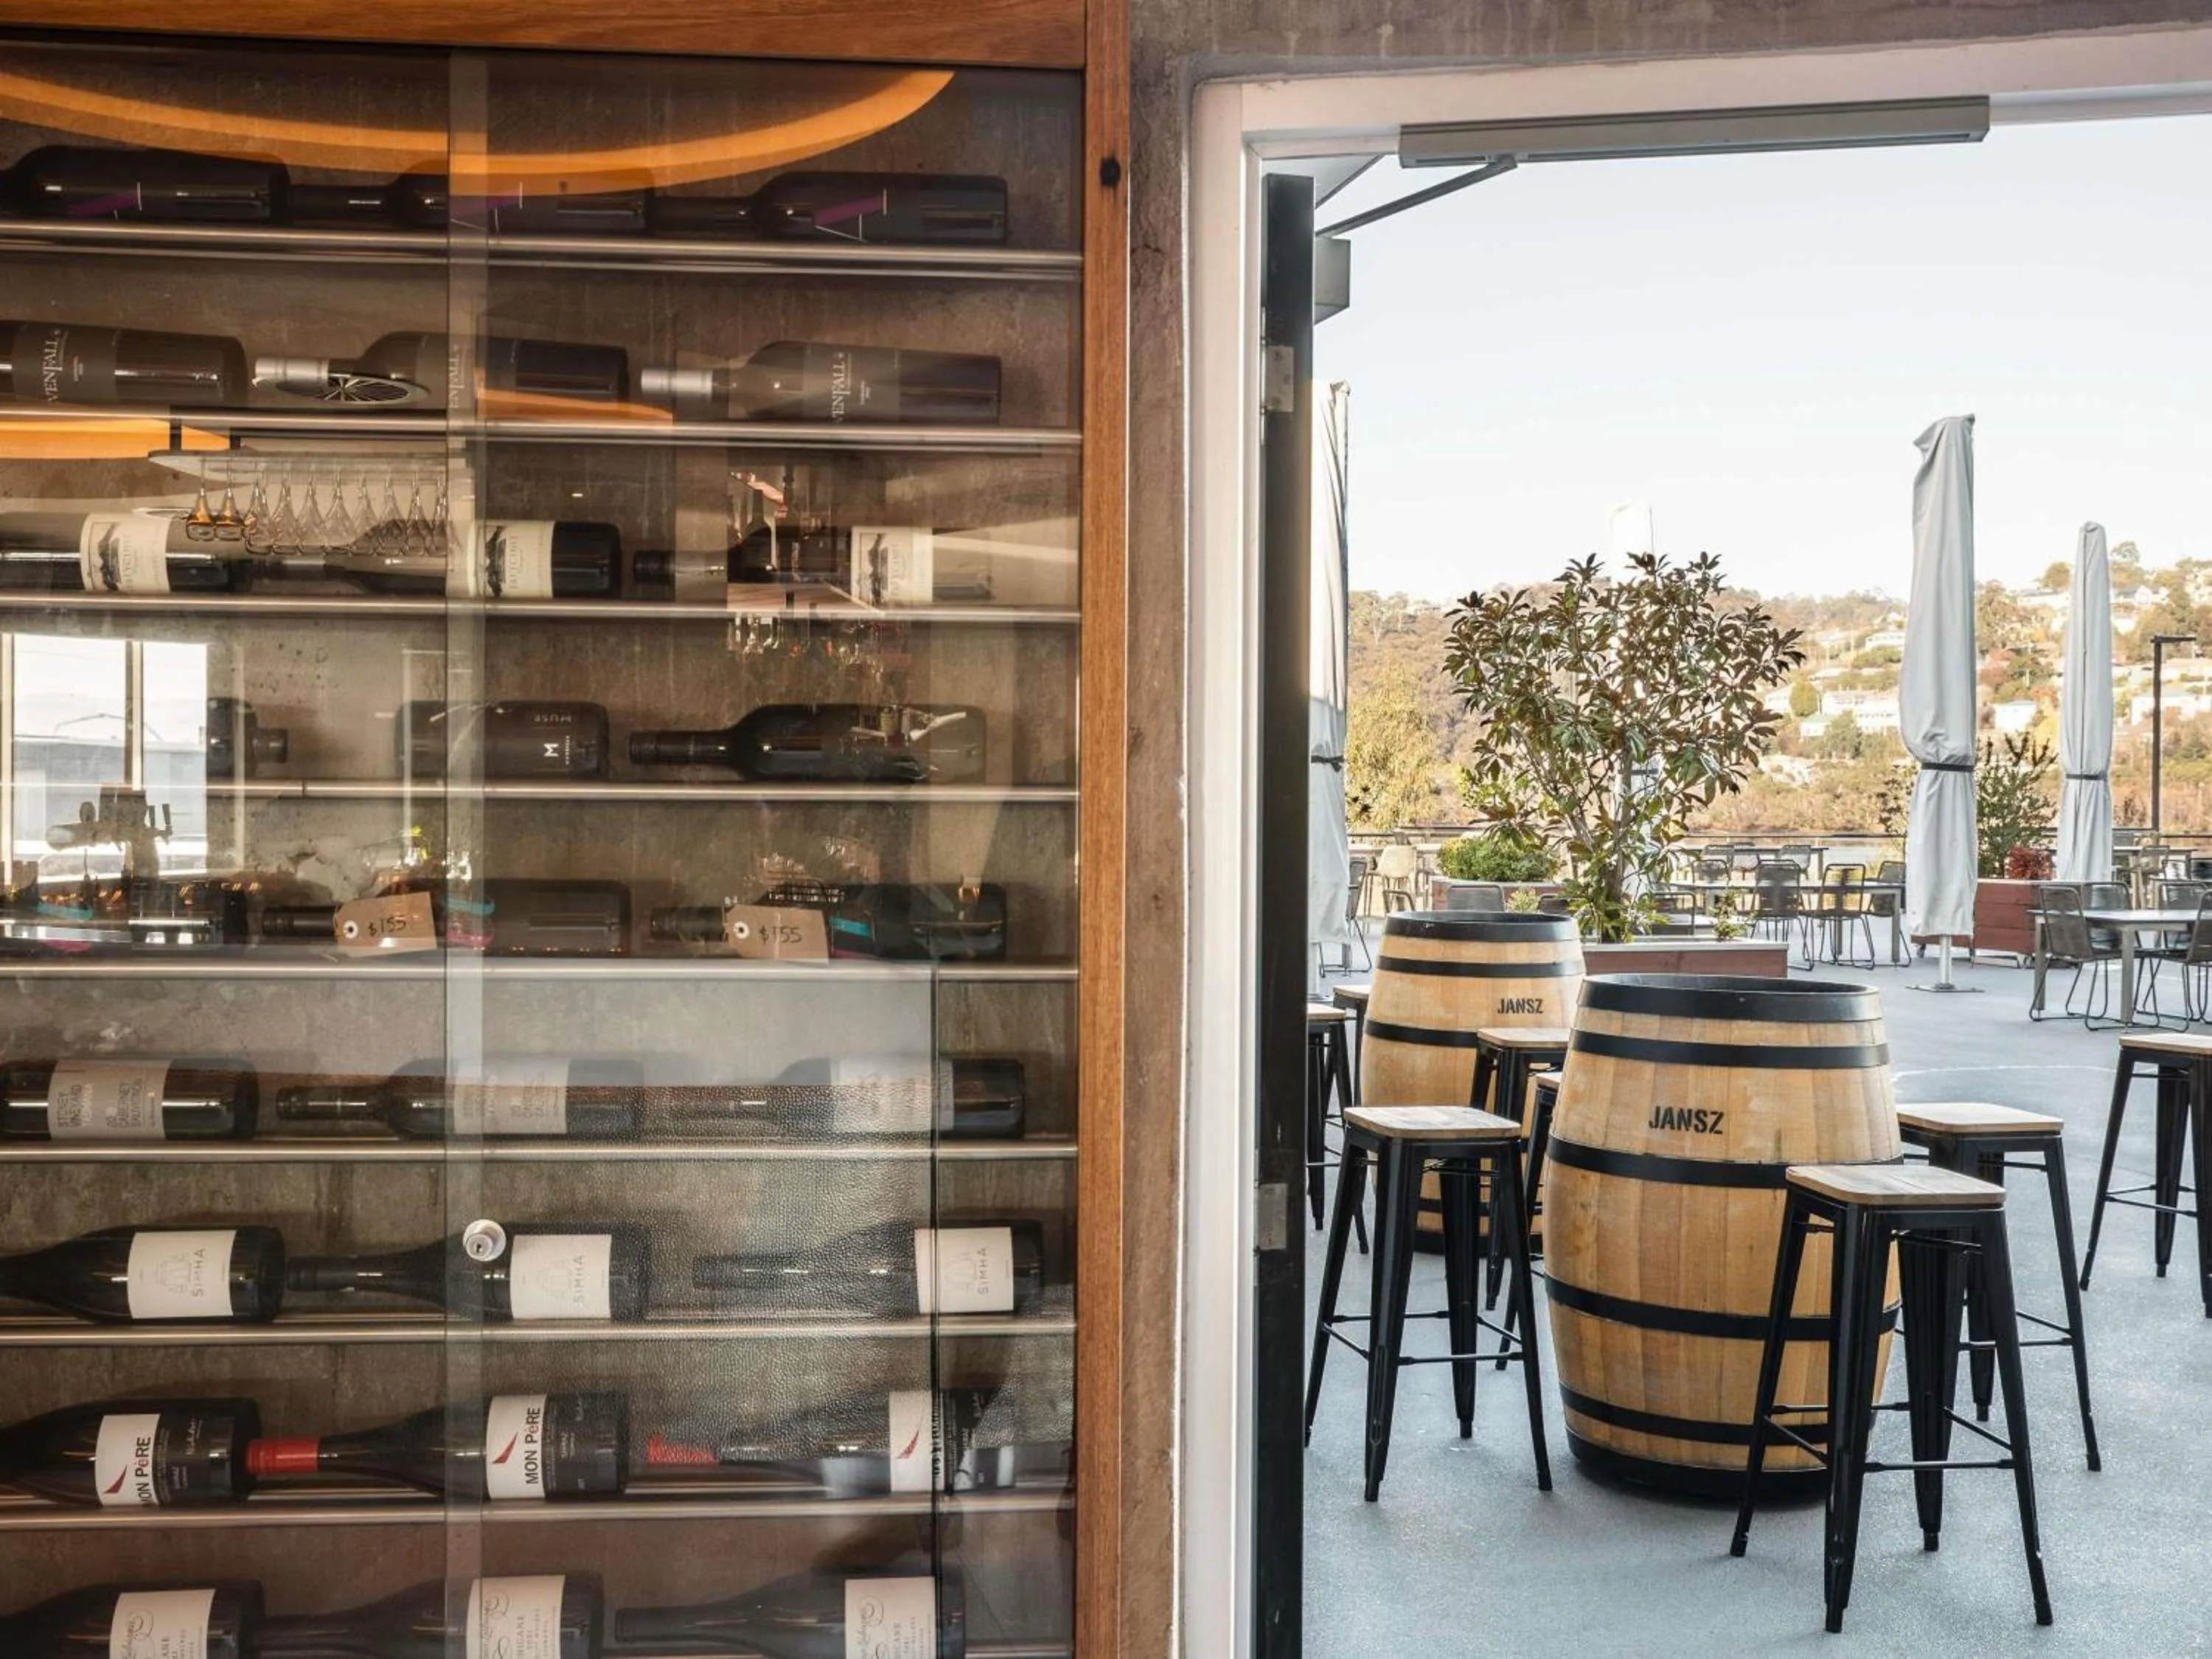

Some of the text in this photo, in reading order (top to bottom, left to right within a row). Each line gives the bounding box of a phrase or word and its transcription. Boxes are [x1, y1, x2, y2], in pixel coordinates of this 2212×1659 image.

[1497, 997, 1544, 1015] JANSZ
[1648, 1105, 1724, 1135] JANSZ
[572, 1255, 585, 1303] SIMHA
[976, 1247, 989, 1295] SIMHA
[524, 1450, 539, 1484] MON
